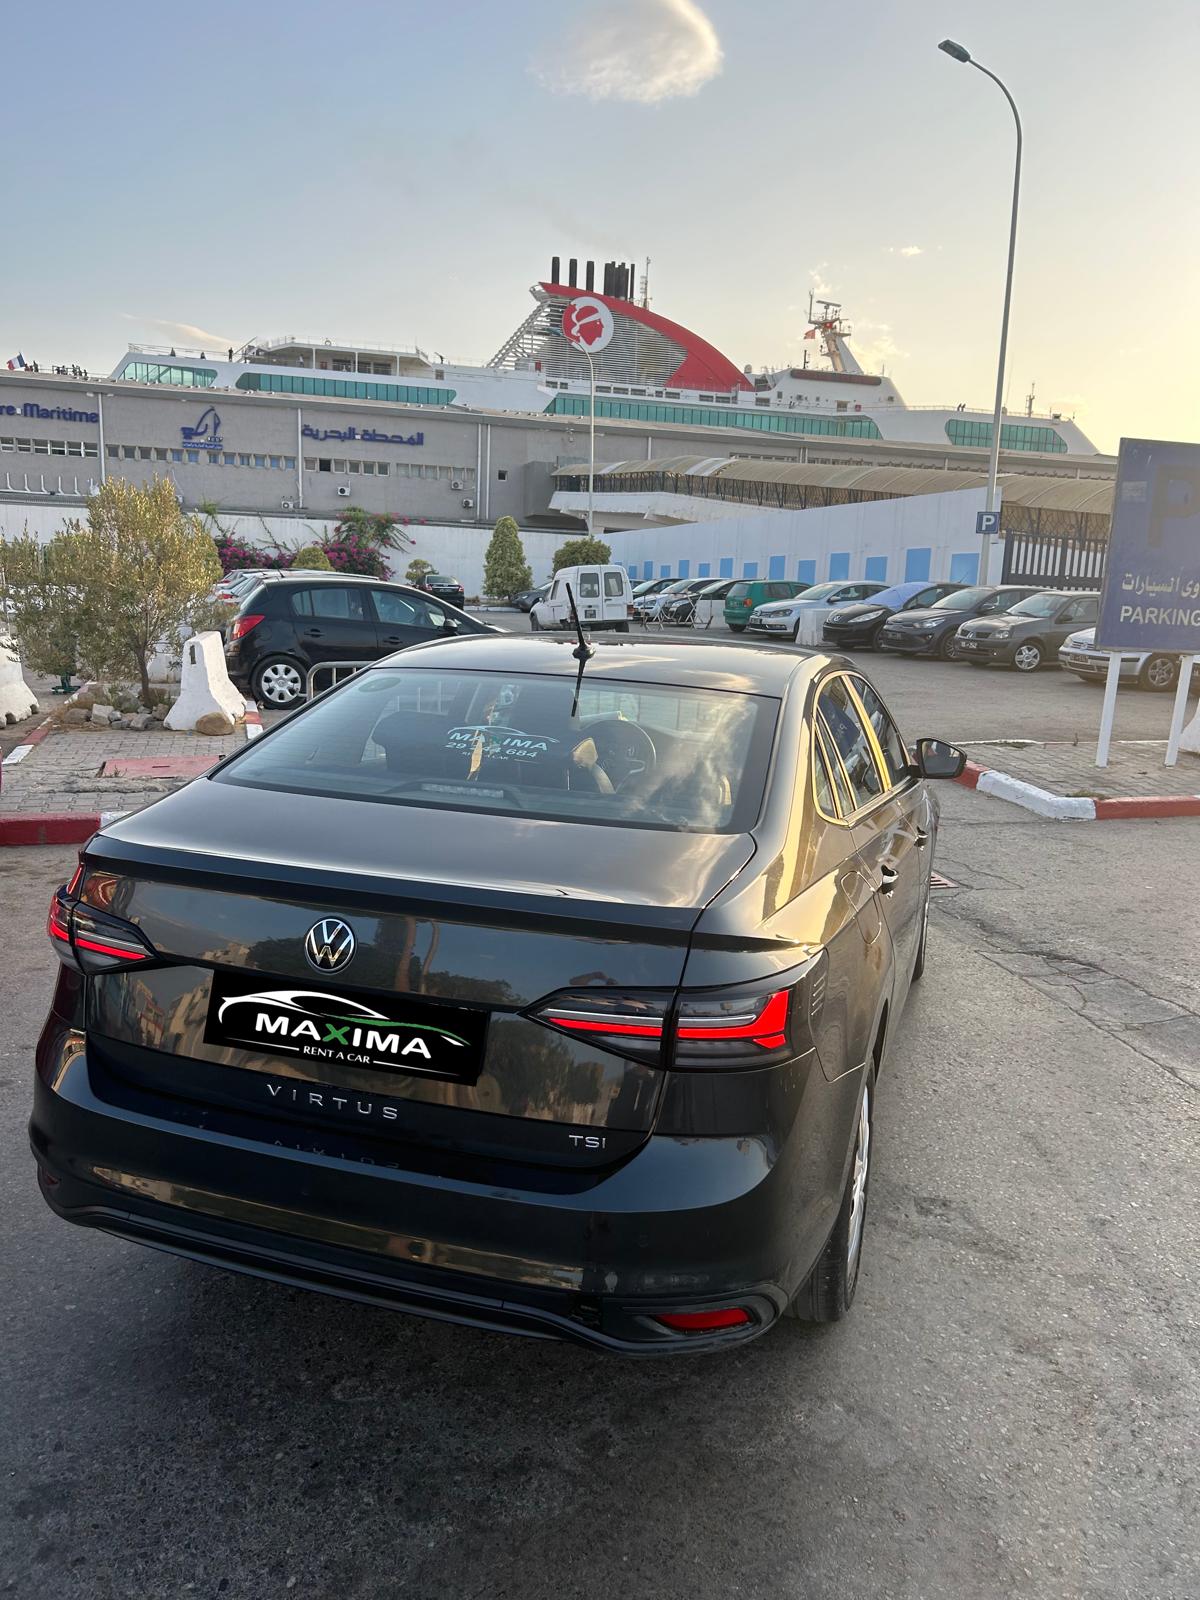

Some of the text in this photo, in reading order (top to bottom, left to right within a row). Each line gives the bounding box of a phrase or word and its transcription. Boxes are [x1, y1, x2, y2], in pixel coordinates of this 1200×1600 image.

[23, 403, 99, 423] Maritime
[302, 423, 424, 445] المحطة البحرية
[981, 514, 995, 531] P
[505, 748, 538, 758] 684
[254, 1012, 432, 1060] MAXIMA
[302, 1046, 371, 1065] RENT A CAR
[265, 1083, 399, 1121] VIRTUS
[568, 1134, 607, 1150] TSI
